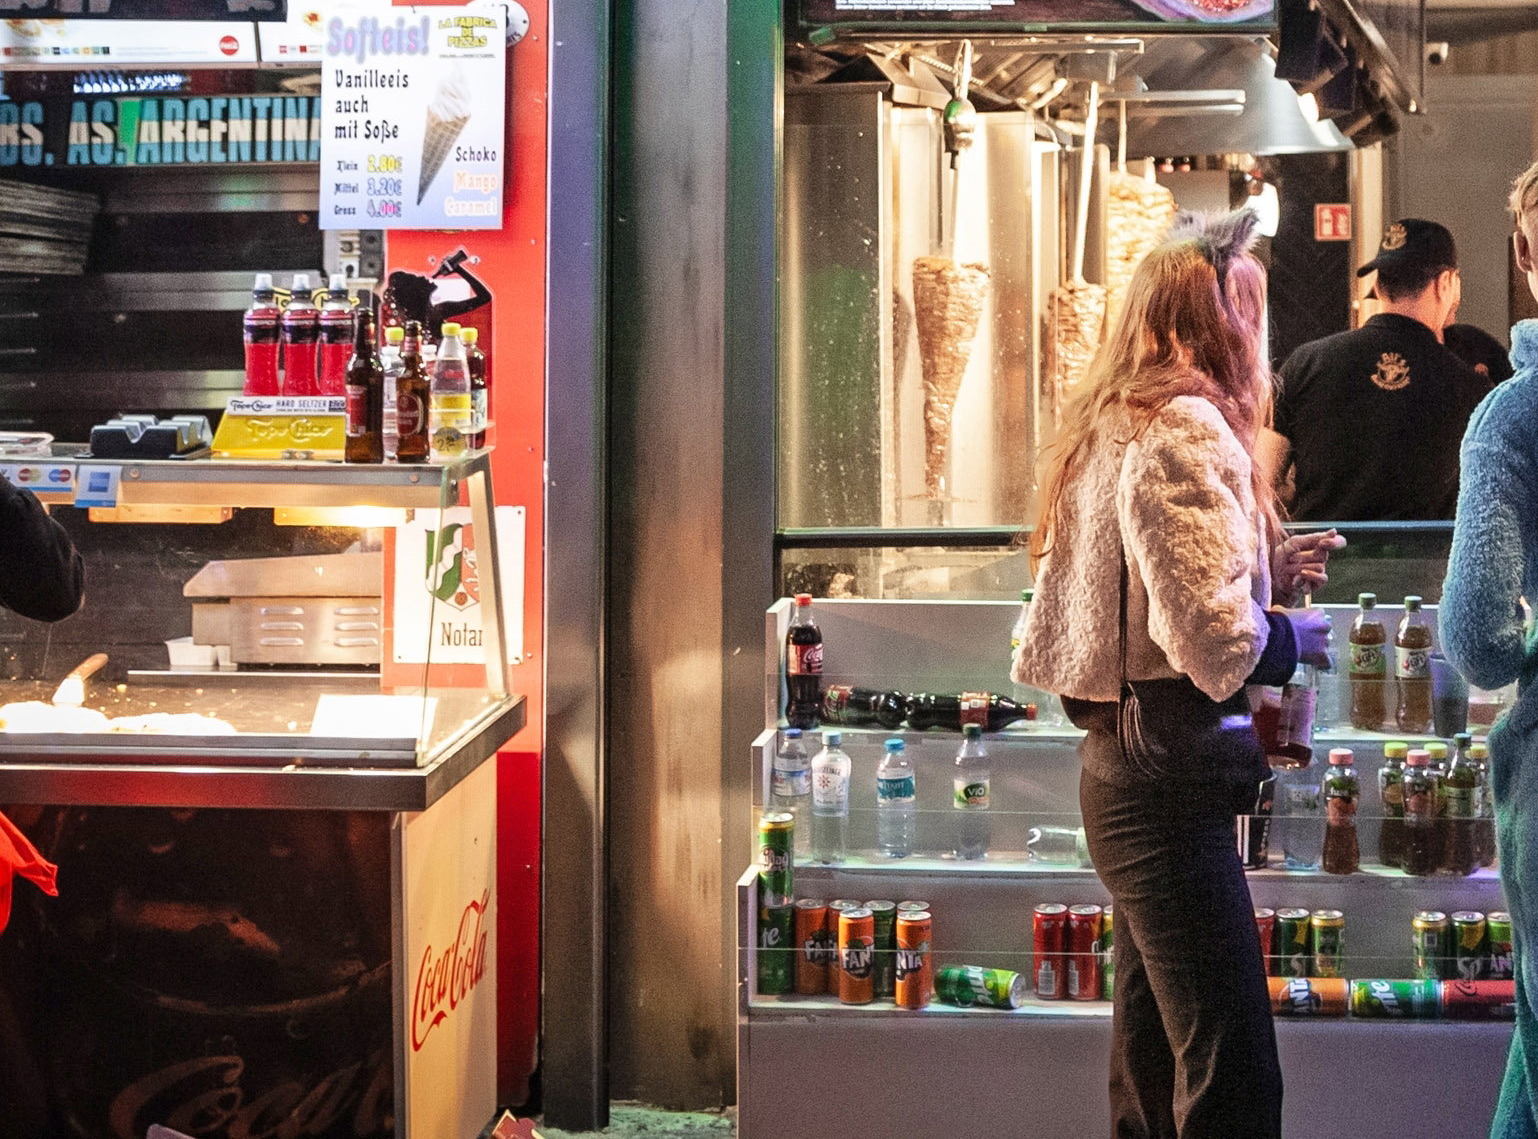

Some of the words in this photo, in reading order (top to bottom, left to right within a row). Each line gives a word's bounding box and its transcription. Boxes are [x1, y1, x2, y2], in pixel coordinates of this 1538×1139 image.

[327, 15, 431, 65] Softeis!
[335, 69, 410, 89] Vanilleeis
[335, 94, 369, 114] auch
[335, 120, 359, 140] mit
[364, 120, 400, 144] Soße
[455, 146, 498, 162] Schoko
